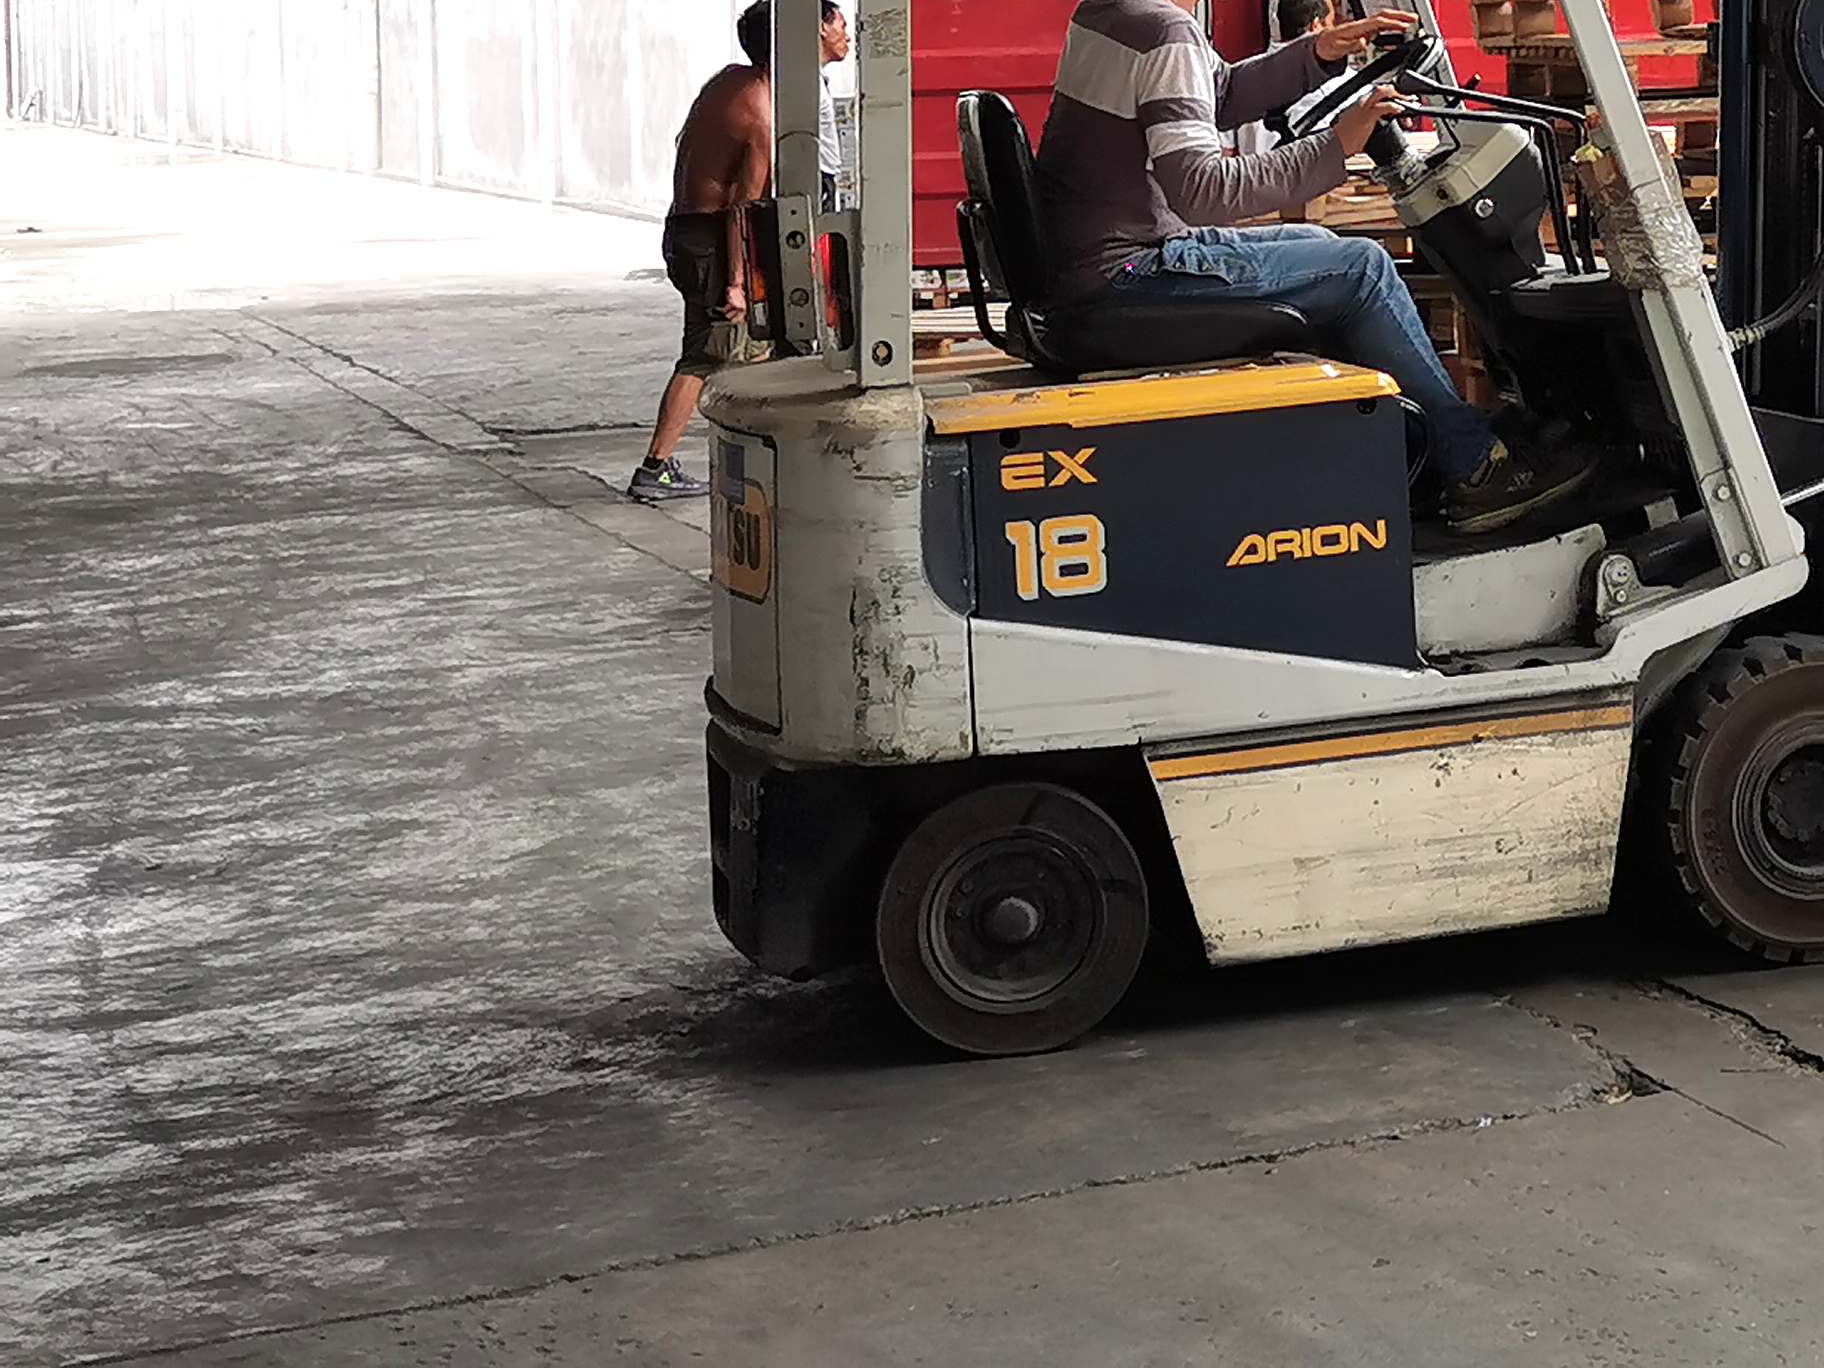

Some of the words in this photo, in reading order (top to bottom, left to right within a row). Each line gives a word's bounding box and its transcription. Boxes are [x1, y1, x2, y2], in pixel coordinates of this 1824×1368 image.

[1000, 447, 1098, 490] EX
[1005, 513, 1108, 601] 18
[1225, 519, 1387, 567] ARION
